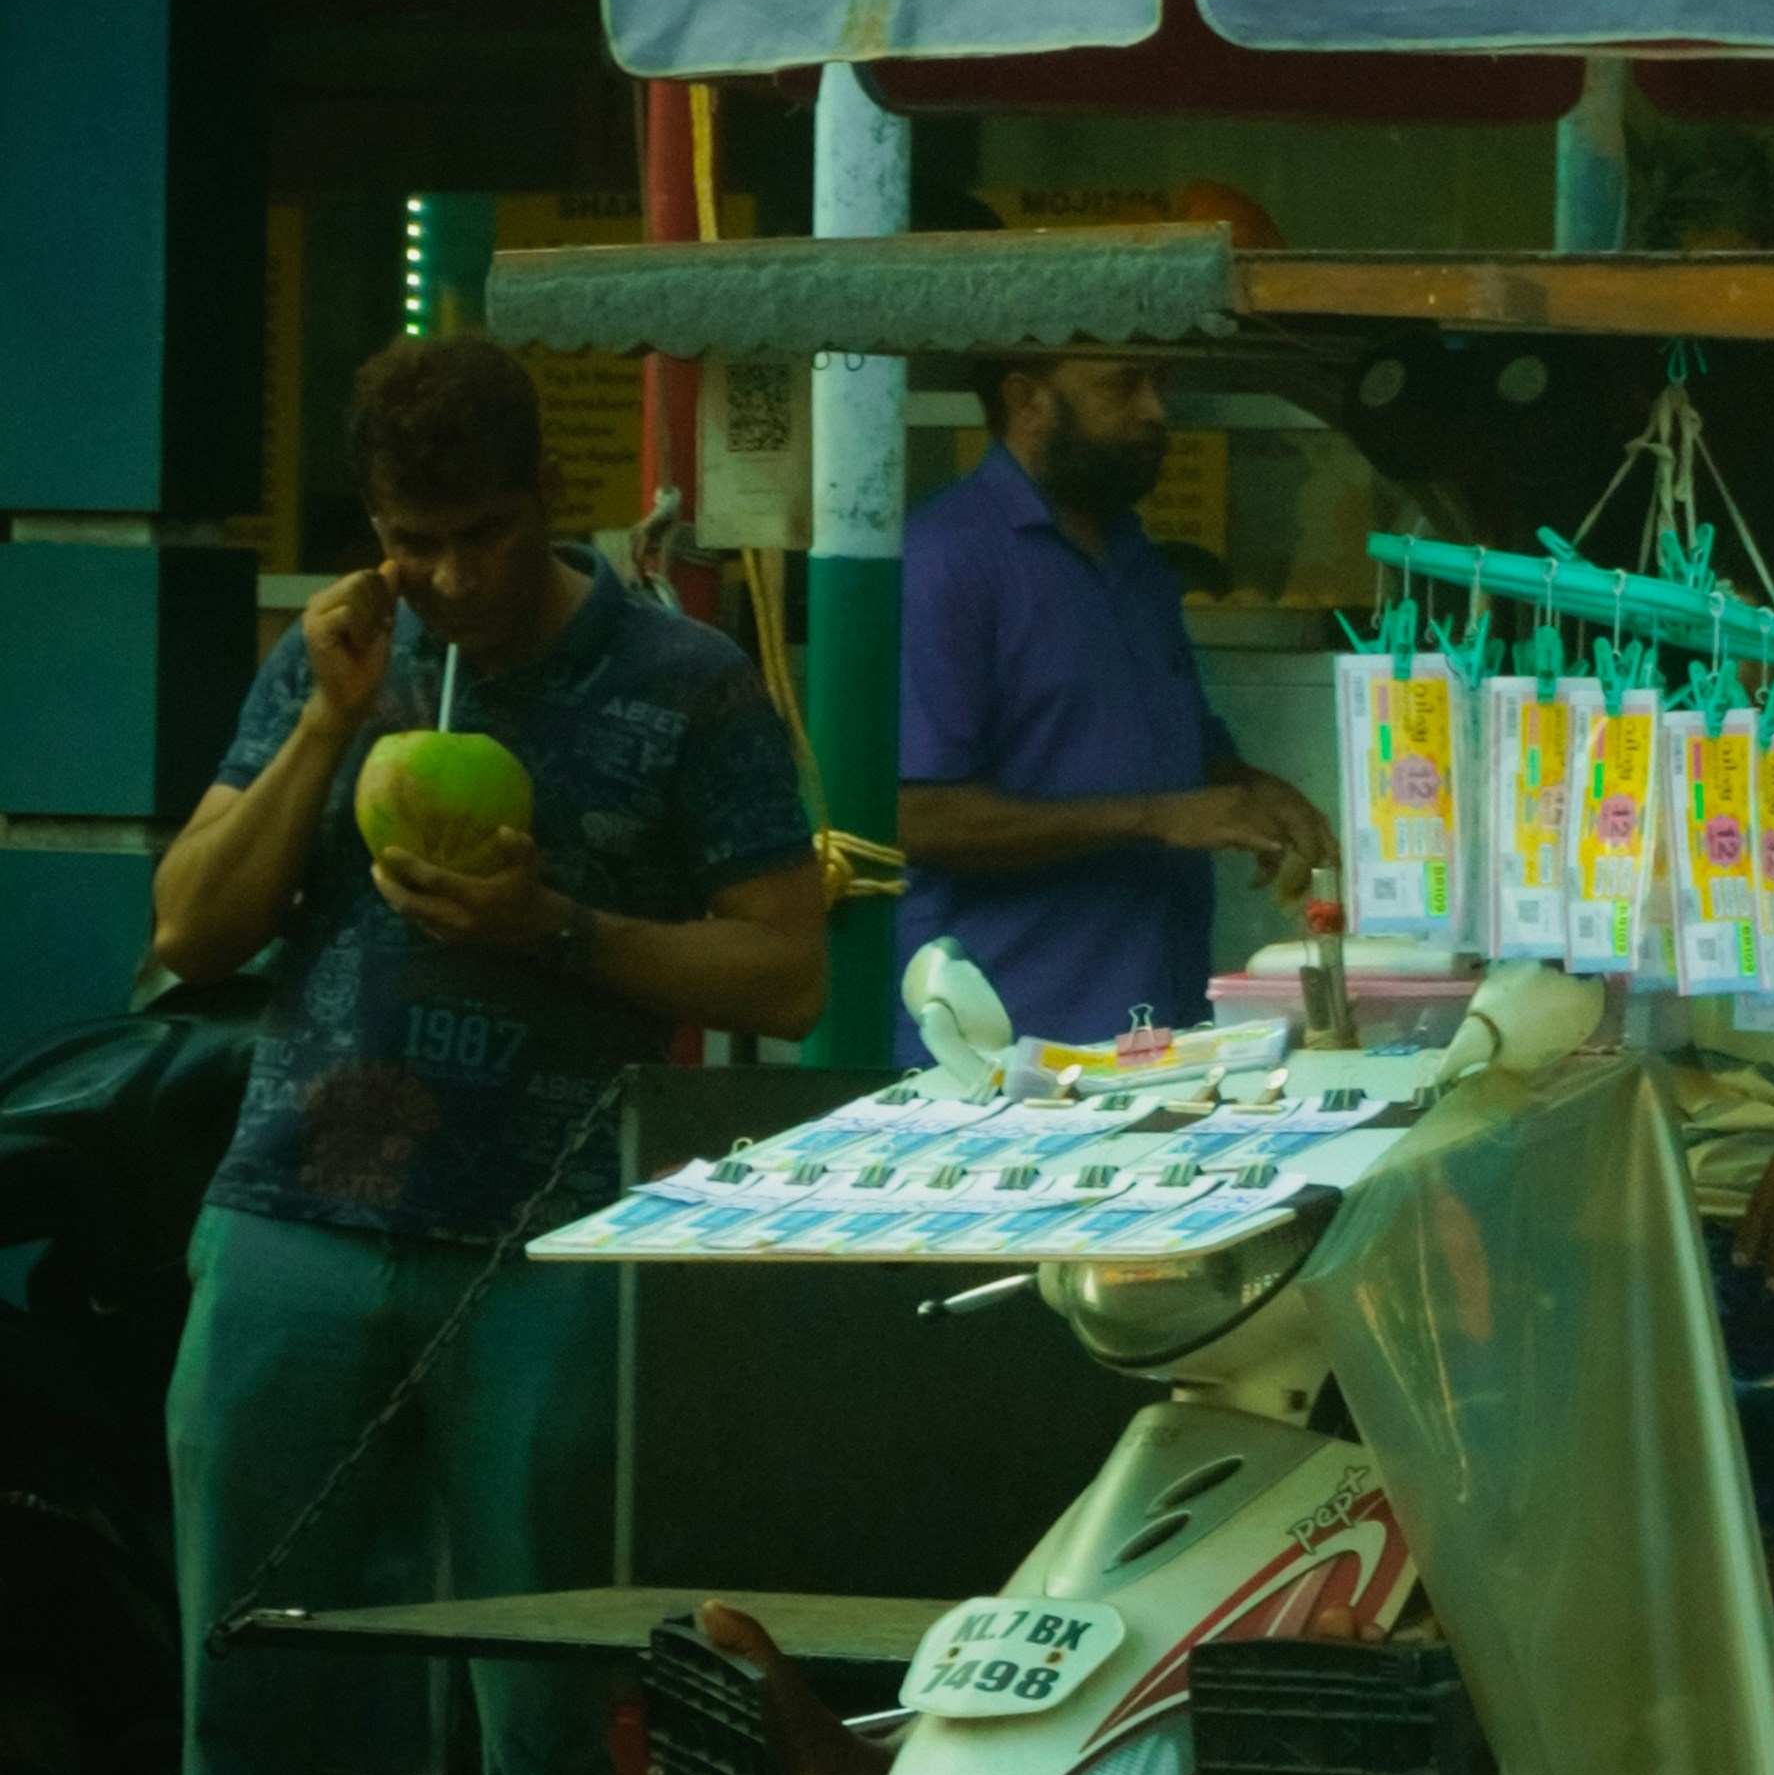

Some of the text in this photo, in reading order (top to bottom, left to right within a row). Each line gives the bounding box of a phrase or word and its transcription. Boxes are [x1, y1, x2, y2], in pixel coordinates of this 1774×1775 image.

[1408, 767, 1433, 800] 12
[1610, 806, 1631, 838] 12
[1716, 826, 1740, 859] 12
[403, 1002, 529, 1073] 1987
[1024, 1613, 1093, 1652] BX
[918, 1659, 1061, 1701] 7498
